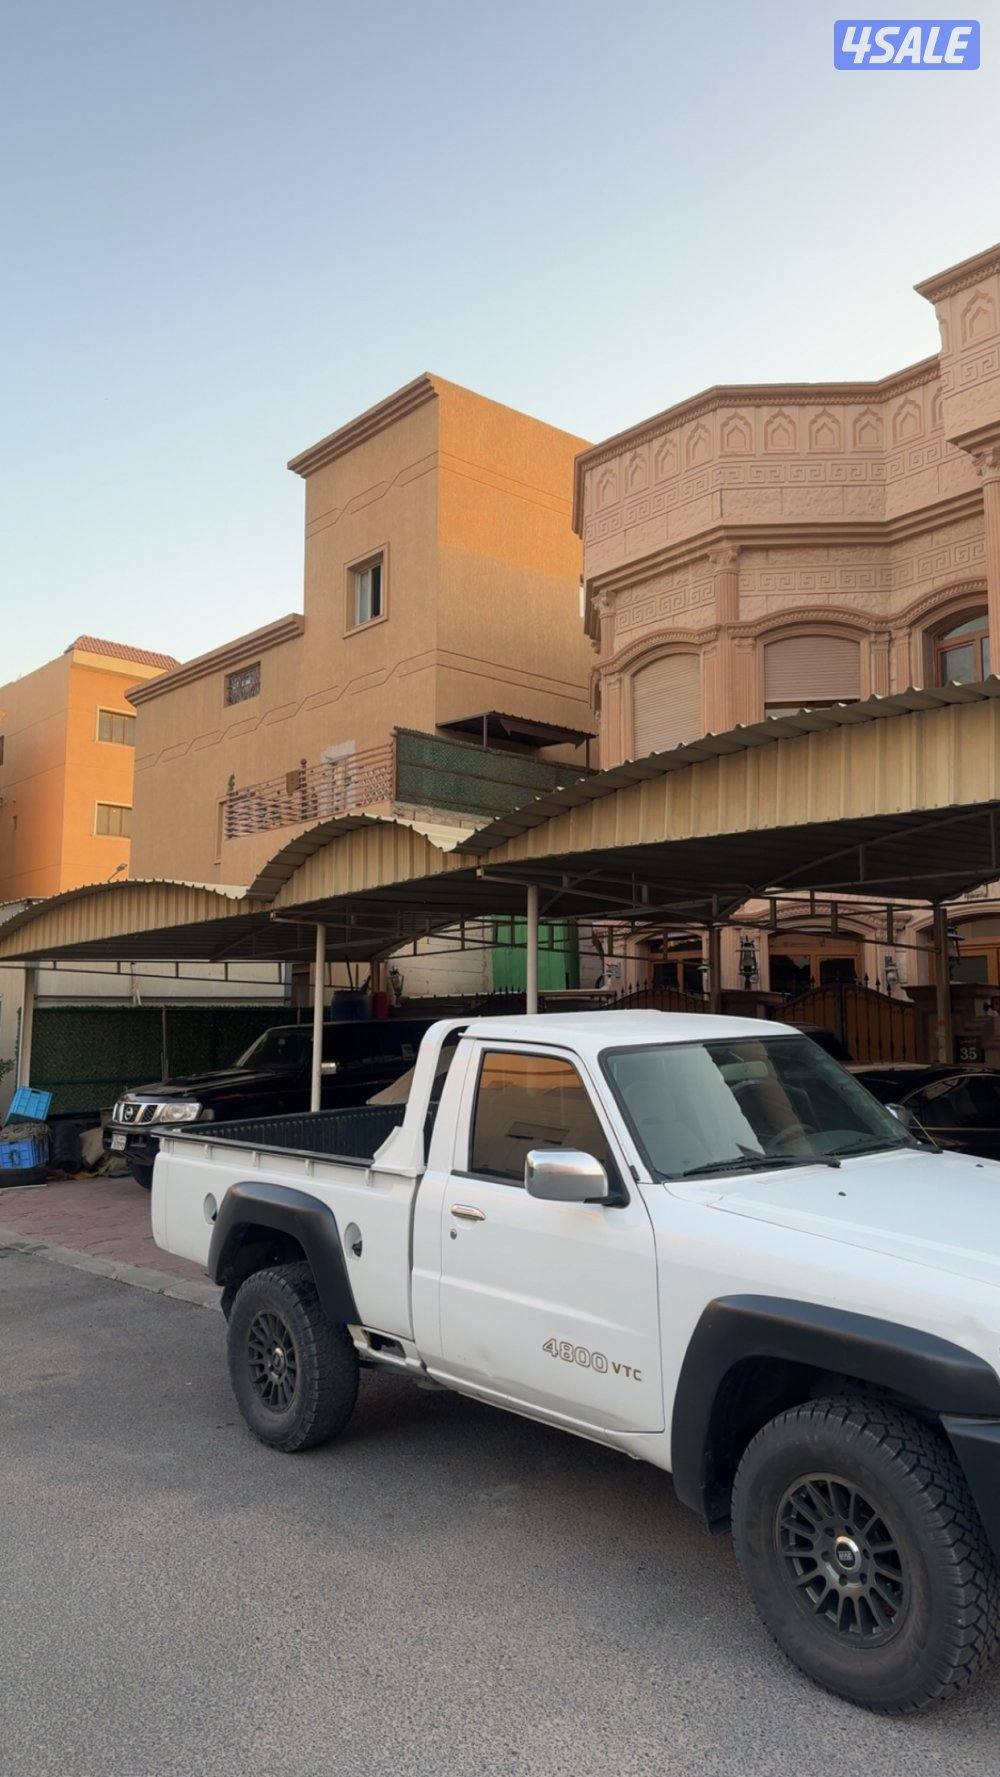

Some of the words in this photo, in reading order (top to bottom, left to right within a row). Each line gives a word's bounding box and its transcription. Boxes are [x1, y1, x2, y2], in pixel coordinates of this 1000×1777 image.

[960, 1047, 977, 1060] 35
[542, 1338, 608, 1374] 4800
[611, 1361, 642, 1382] VTC
